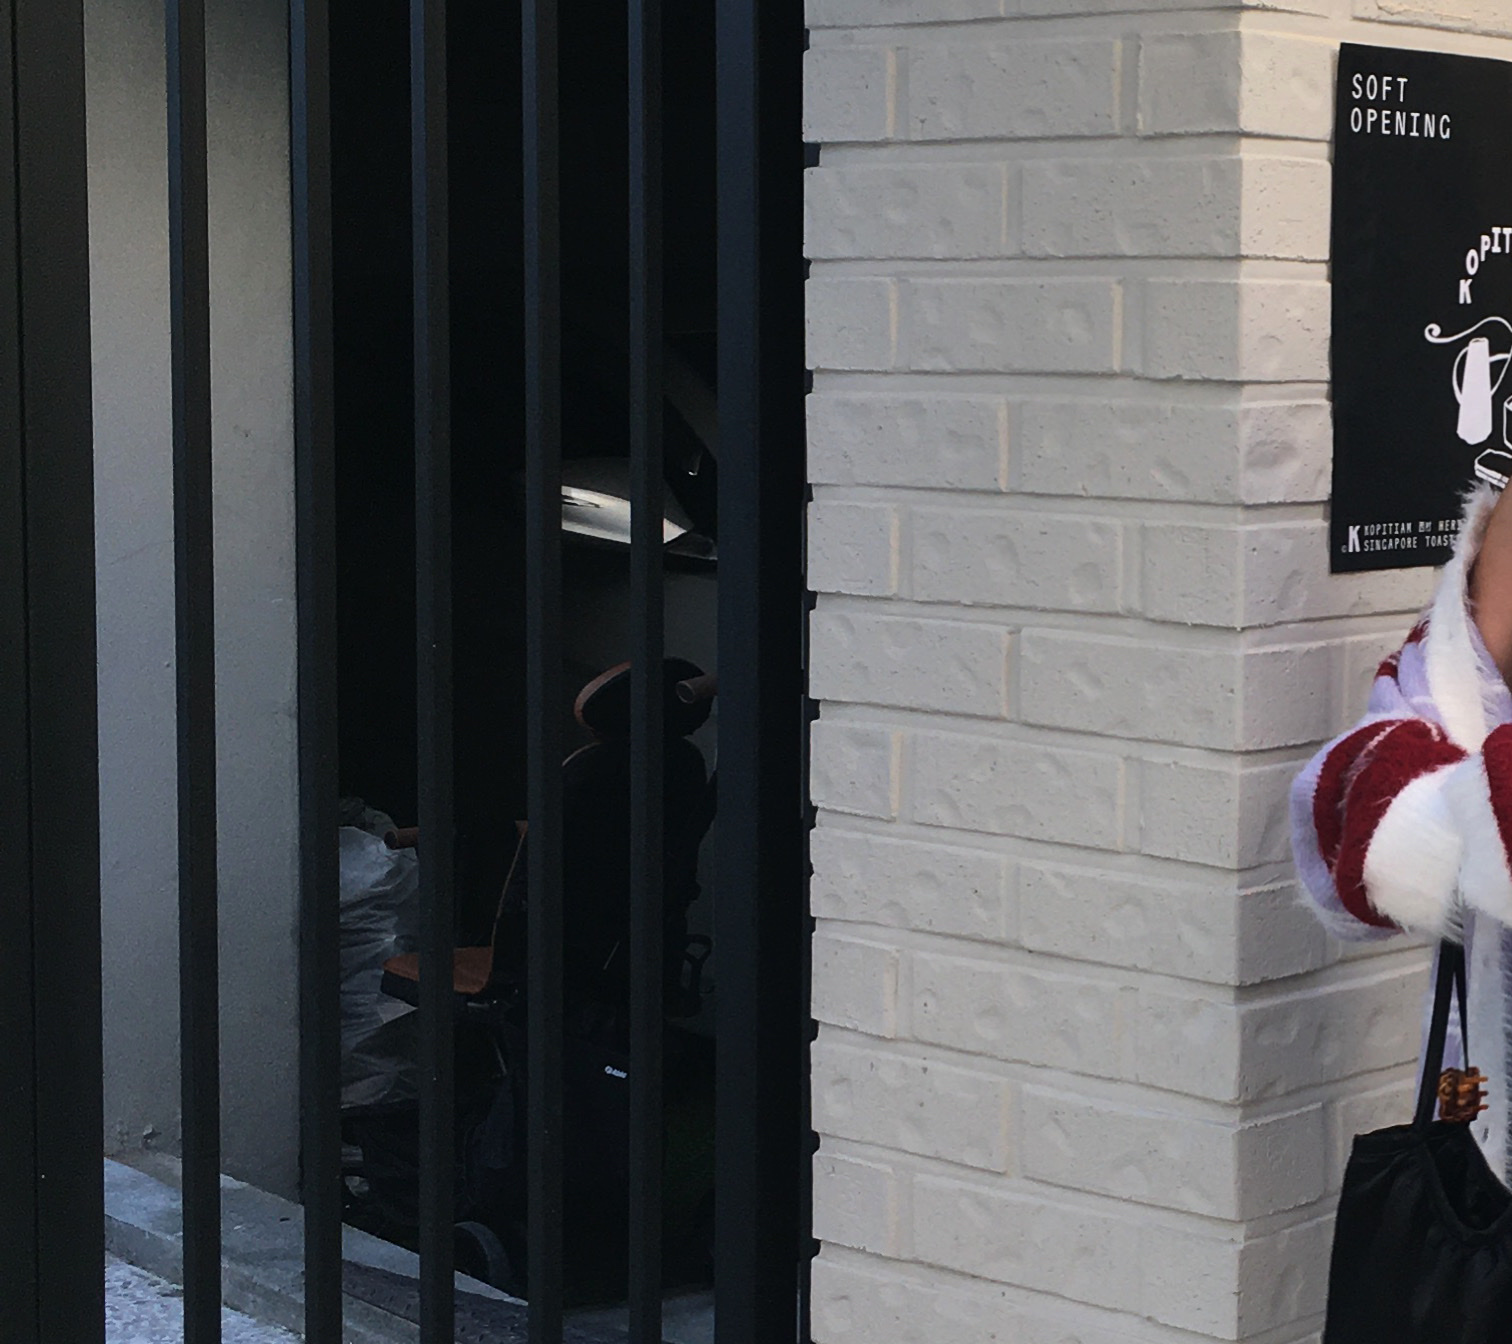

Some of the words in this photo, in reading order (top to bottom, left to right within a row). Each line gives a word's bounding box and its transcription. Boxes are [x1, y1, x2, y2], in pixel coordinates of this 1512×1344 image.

[1351, 73, 1409, 103] SOFT
[1350, 107, 1452, 140] OPENING
[1364, 522, 1412, 536] KOPITIAM
[1438, 519, 1462, 532] HERI
[1363, 536, 1418, 552] SINGAPORE
